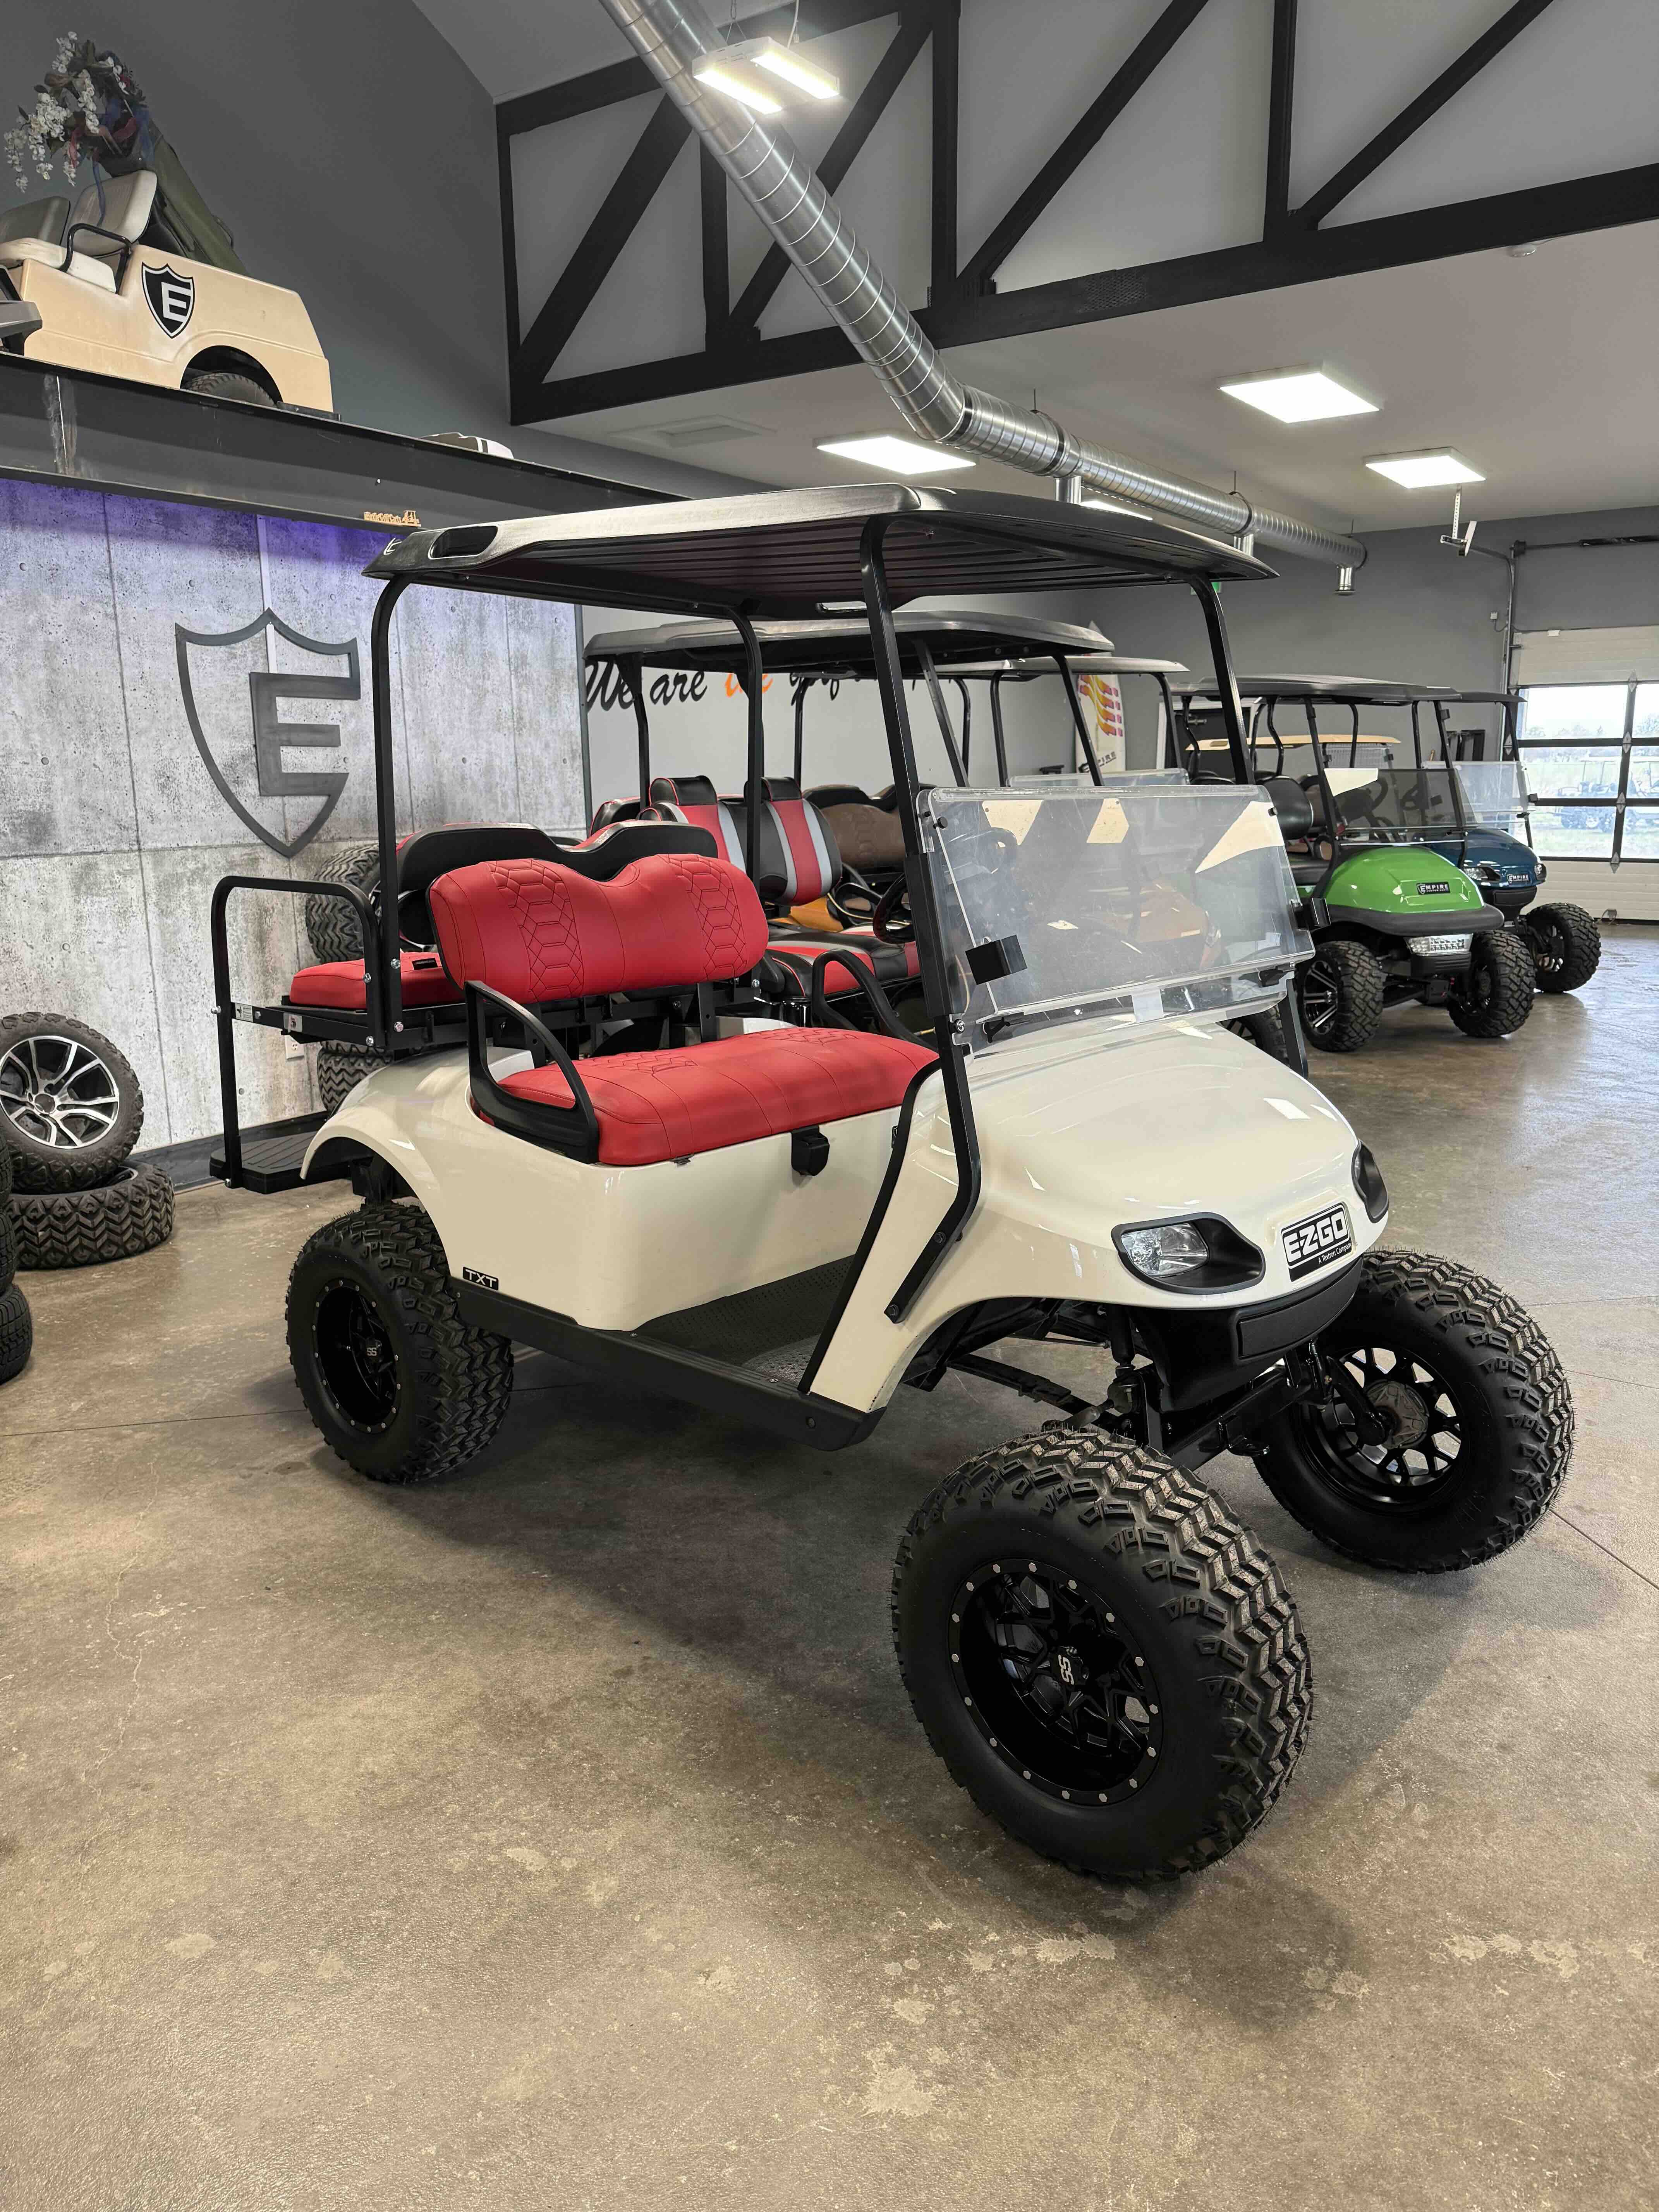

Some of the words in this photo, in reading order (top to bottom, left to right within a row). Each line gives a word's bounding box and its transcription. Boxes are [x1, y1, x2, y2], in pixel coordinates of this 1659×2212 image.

[161, 282, 194, 323] E
[585, 661, 634, 713] We
[649, 671, 708, 706] are
[249, 672, 361, 797] E
[1420, 884, 1449, 892] EMPIRE
[1321, 1250, 1336, 1262] Textron
[465, 1269, 497, 1288] TXT
